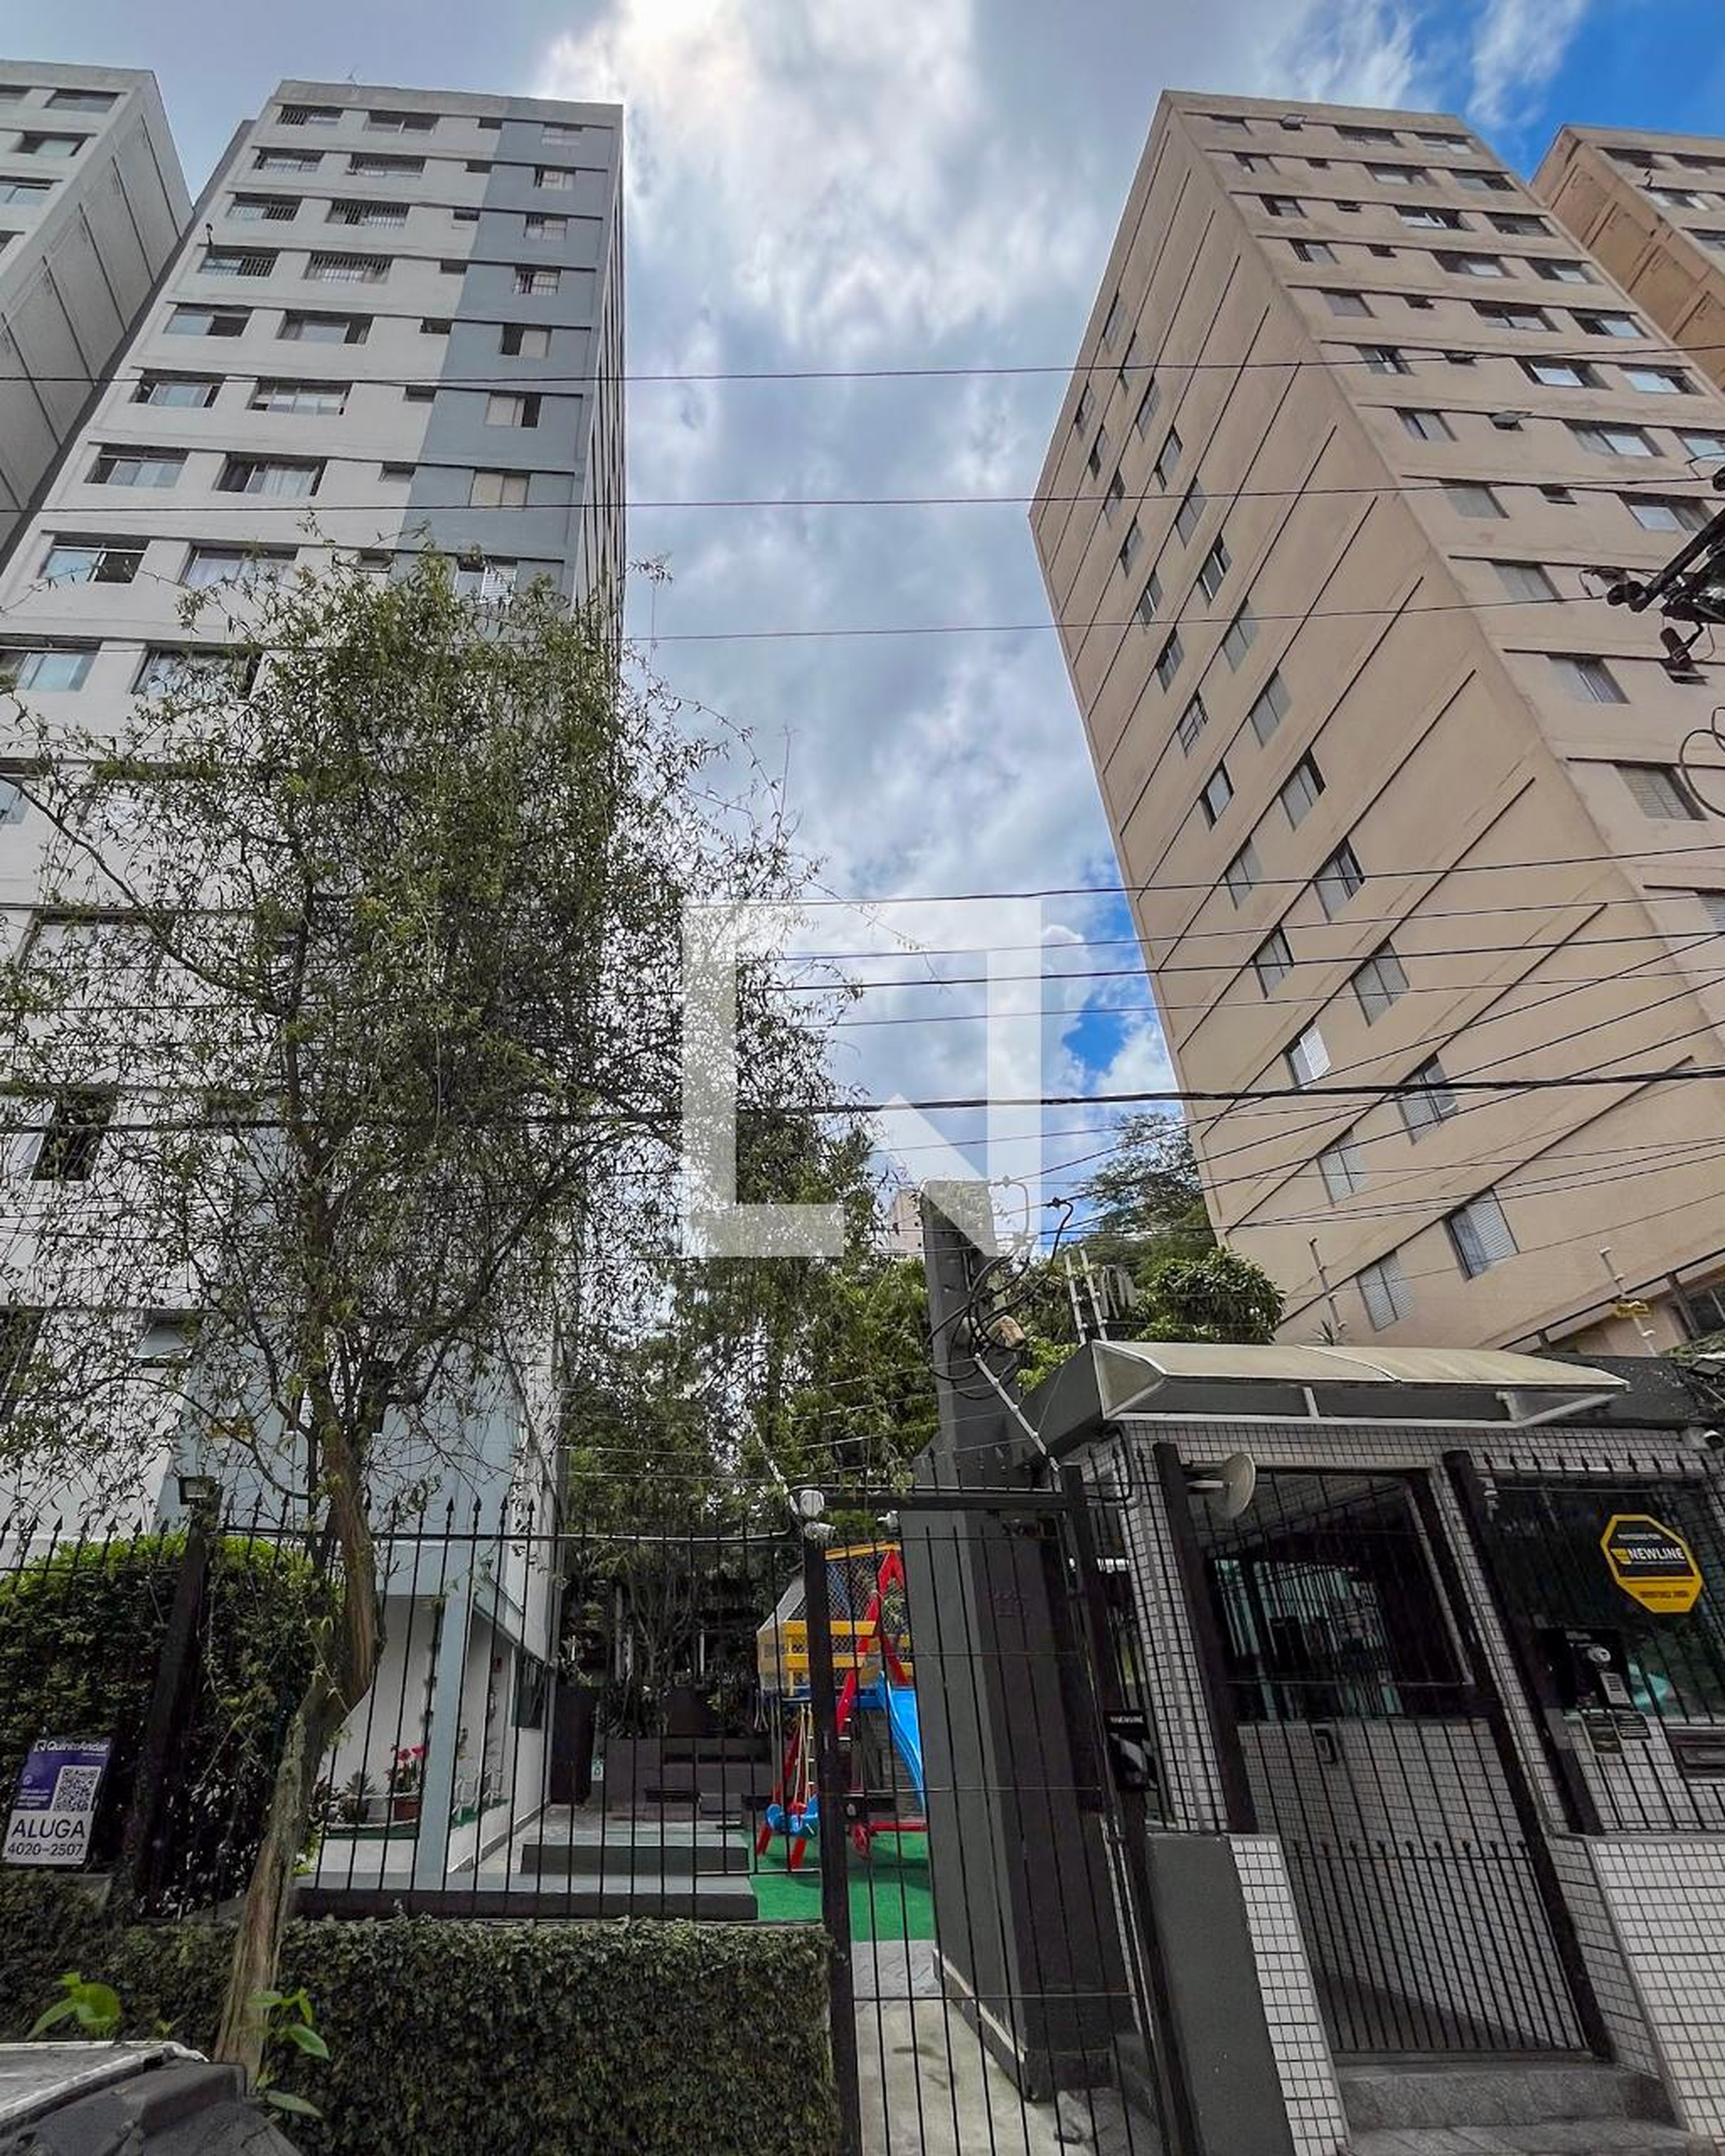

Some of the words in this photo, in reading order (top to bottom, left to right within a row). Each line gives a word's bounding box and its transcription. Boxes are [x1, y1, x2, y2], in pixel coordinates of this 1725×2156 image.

[1627, 1548, 1685, 1560] NEWLINE
[12, 1819, 85, 1838] ALUGA
[8, 1842, 83, 1856] 4020-2507
